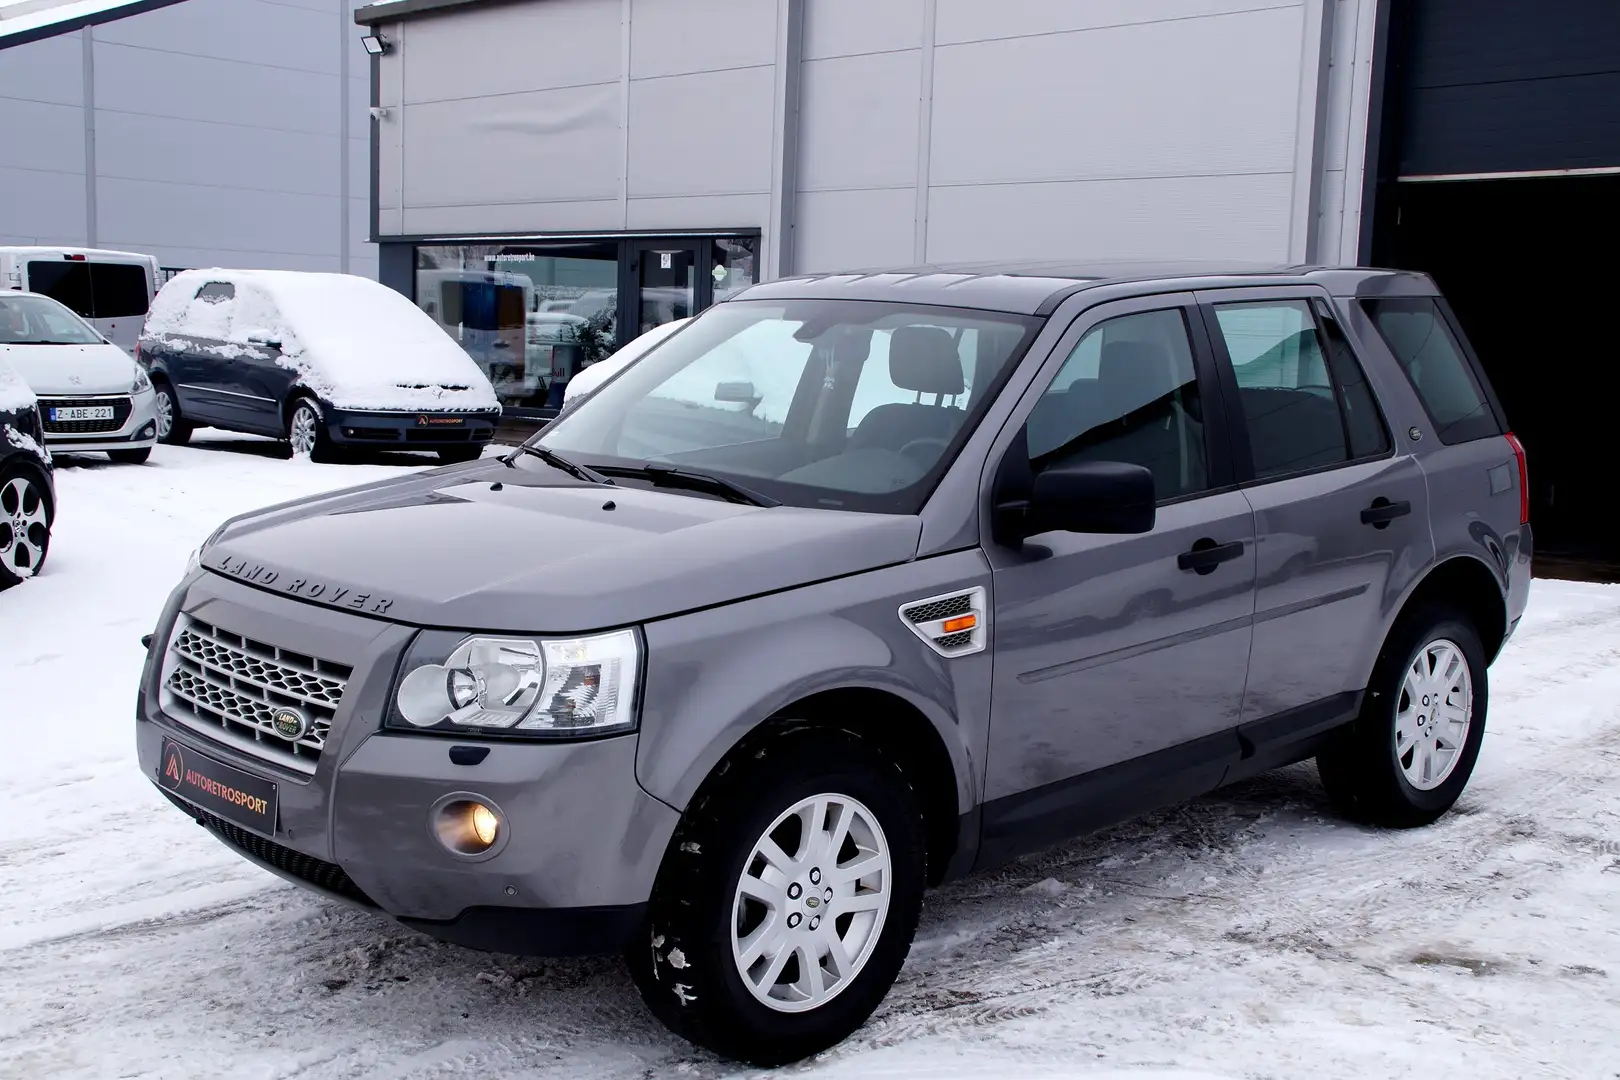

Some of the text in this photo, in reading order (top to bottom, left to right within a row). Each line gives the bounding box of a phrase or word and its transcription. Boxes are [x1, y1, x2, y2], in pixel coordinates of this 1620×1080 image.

[57, 408, 112, 419] Z-ABE-221
[217, 556, 394, 614] LAND ROVER
[278, 713, 295, 724] LAND
[278, 721, 297, 733] ROVER
[185, 768, 268, 815] AUTORETROSPORT
